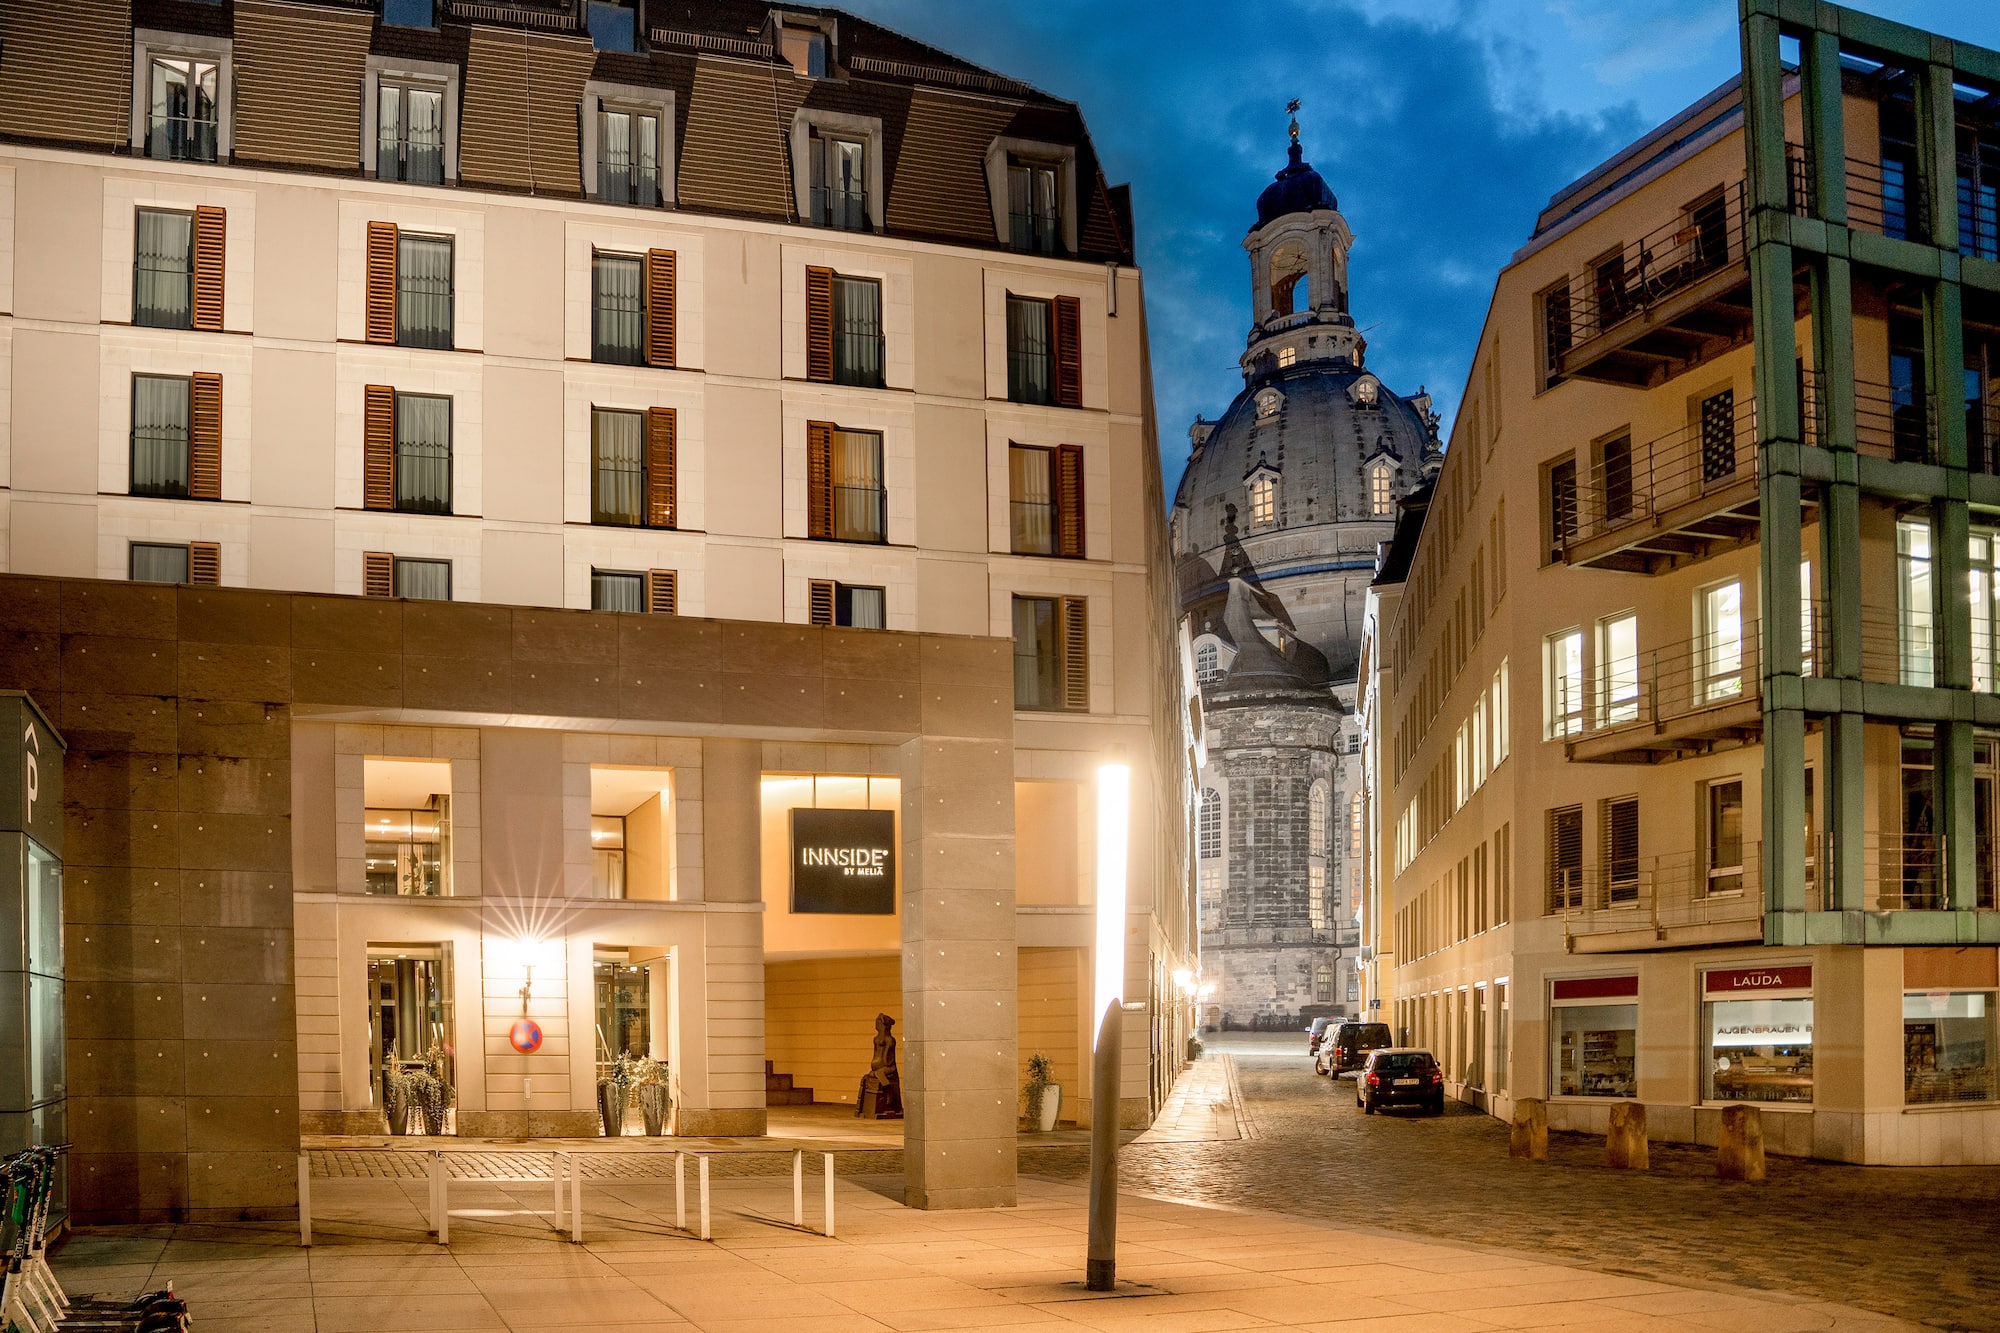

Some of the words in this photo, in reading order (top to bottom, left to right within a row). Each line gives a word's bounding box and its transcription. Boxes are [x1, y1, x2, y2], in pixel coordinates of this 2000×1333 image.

[27, 751, 39, 824] P
[803, 848, 884, 866] INNSIDE
[844, 867, 855, 876] BY
[1733, 975, 1782, 986] LAUDA
[1717, 1024, 1800, 1035] AUGENBRAUEN
